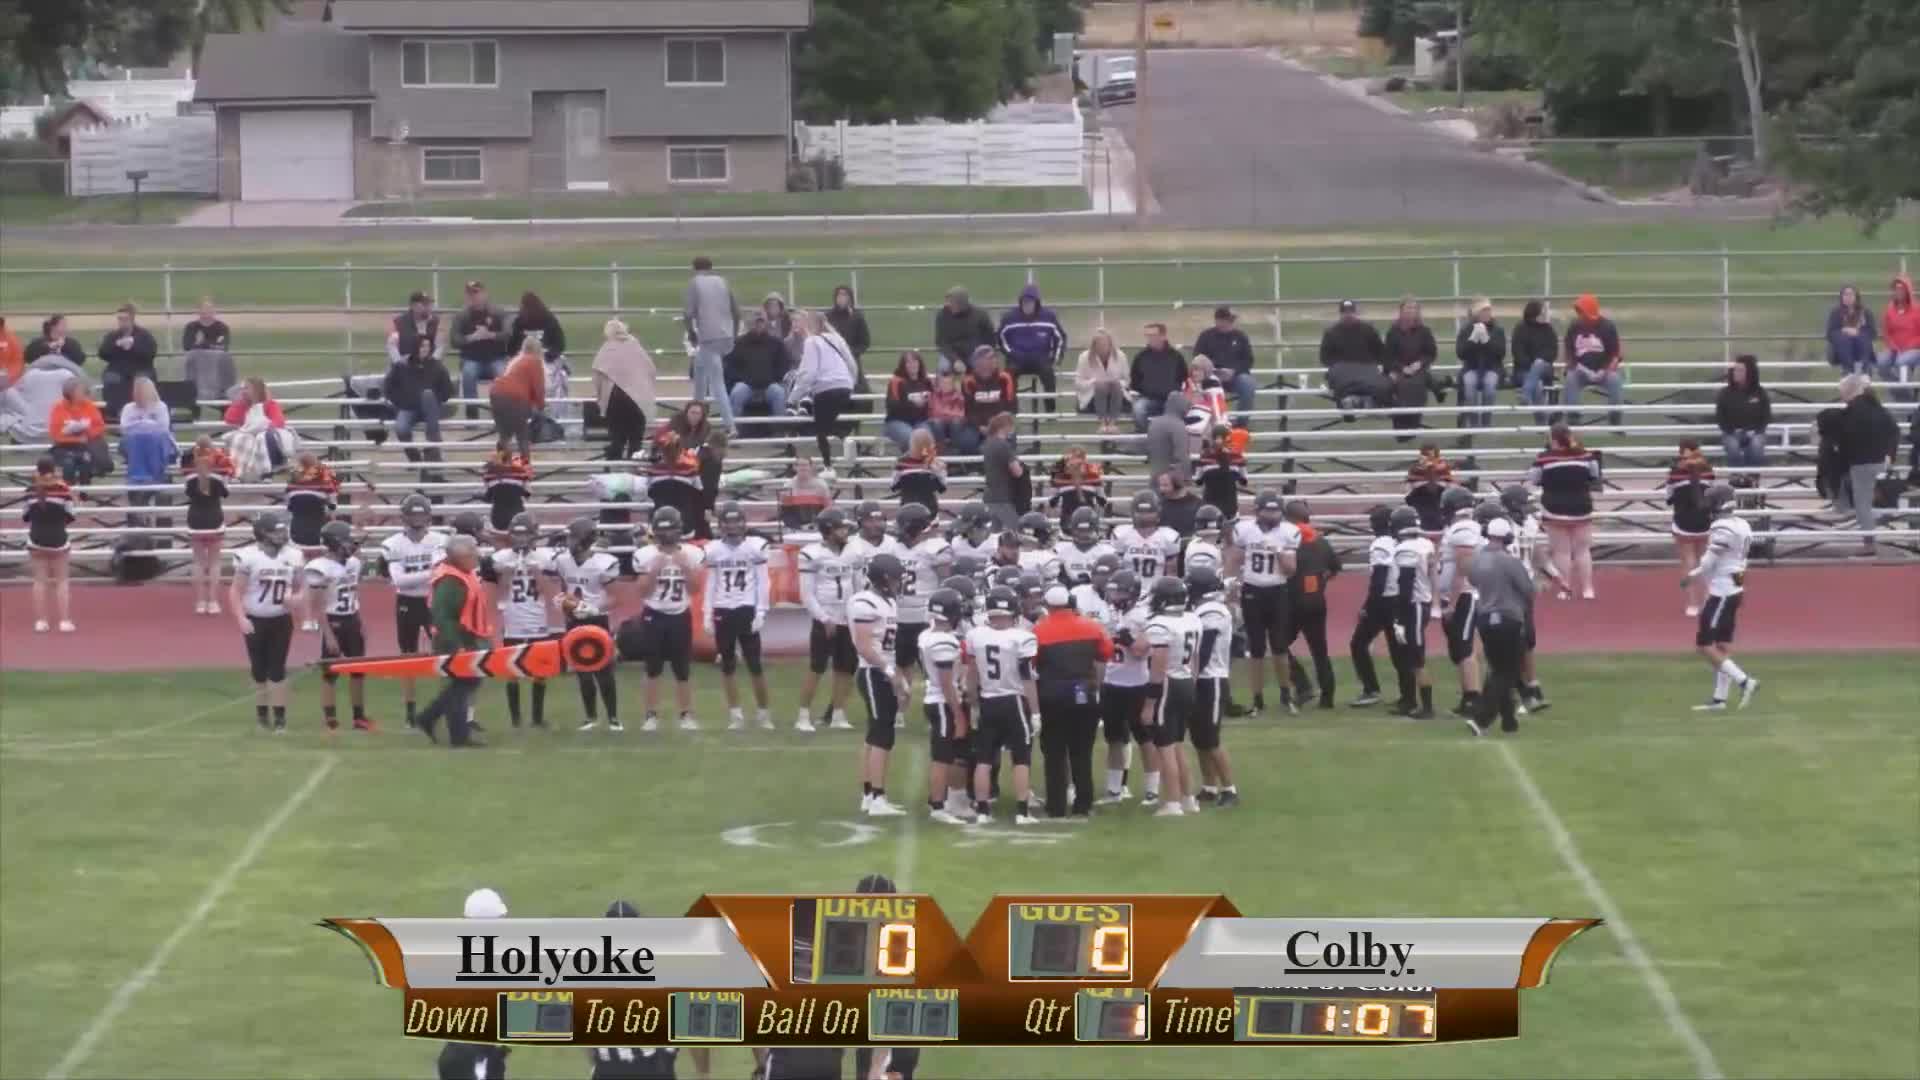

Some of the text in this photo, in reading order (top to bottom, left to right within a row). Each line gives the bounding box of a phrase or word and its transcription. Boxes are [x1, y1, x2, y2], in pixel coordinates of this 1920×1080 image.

[258, 579, 287, 606] 70
[512, 578, 540, 603] 24
[723, 570, 747, 593] 14
[985, 644, 1001, 680] 5
